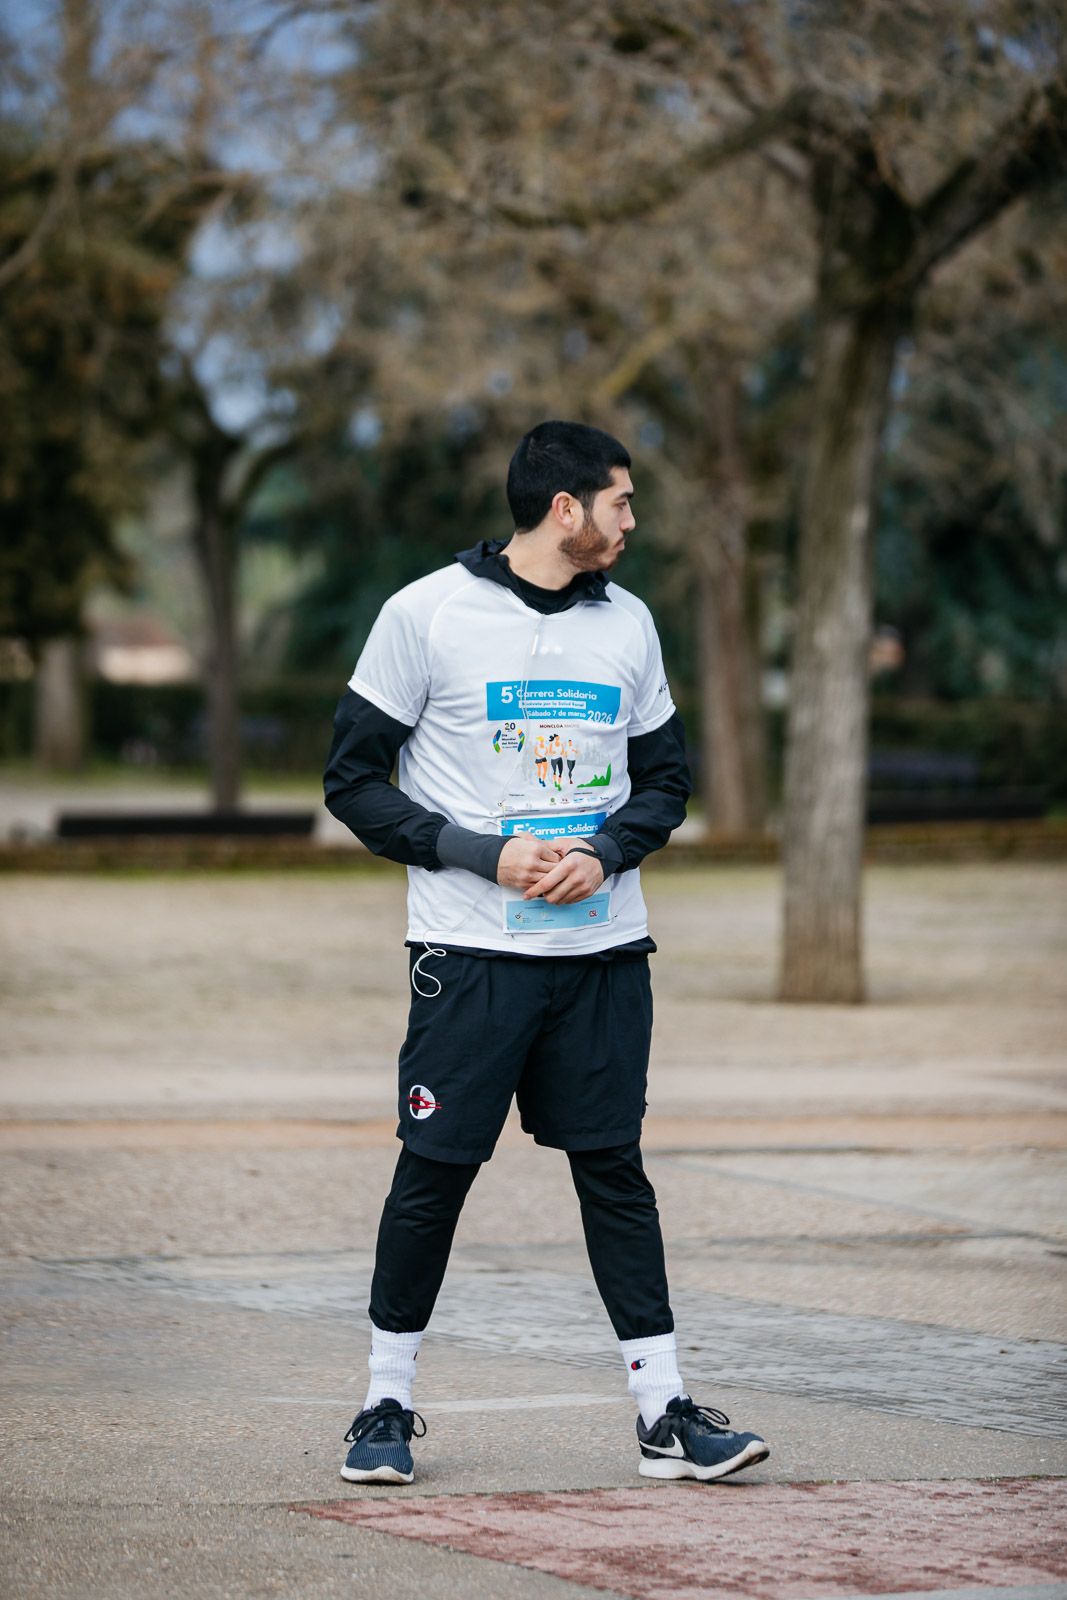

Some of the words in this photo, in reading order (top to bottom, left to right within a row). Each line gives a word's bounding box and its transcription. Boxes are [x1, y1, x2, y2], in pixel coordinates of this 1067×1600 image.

[516, 689, 554, 698] Carrera
[557, 688, 597, 701] Solidaria
[528, 709, 551, 717] Sábado
[568, 711, 586, 719] marzo
[588, 710, 612, 725] 2026
[504, 722, 516, 731] 20
[528, 826, 565, 836] Carrera
